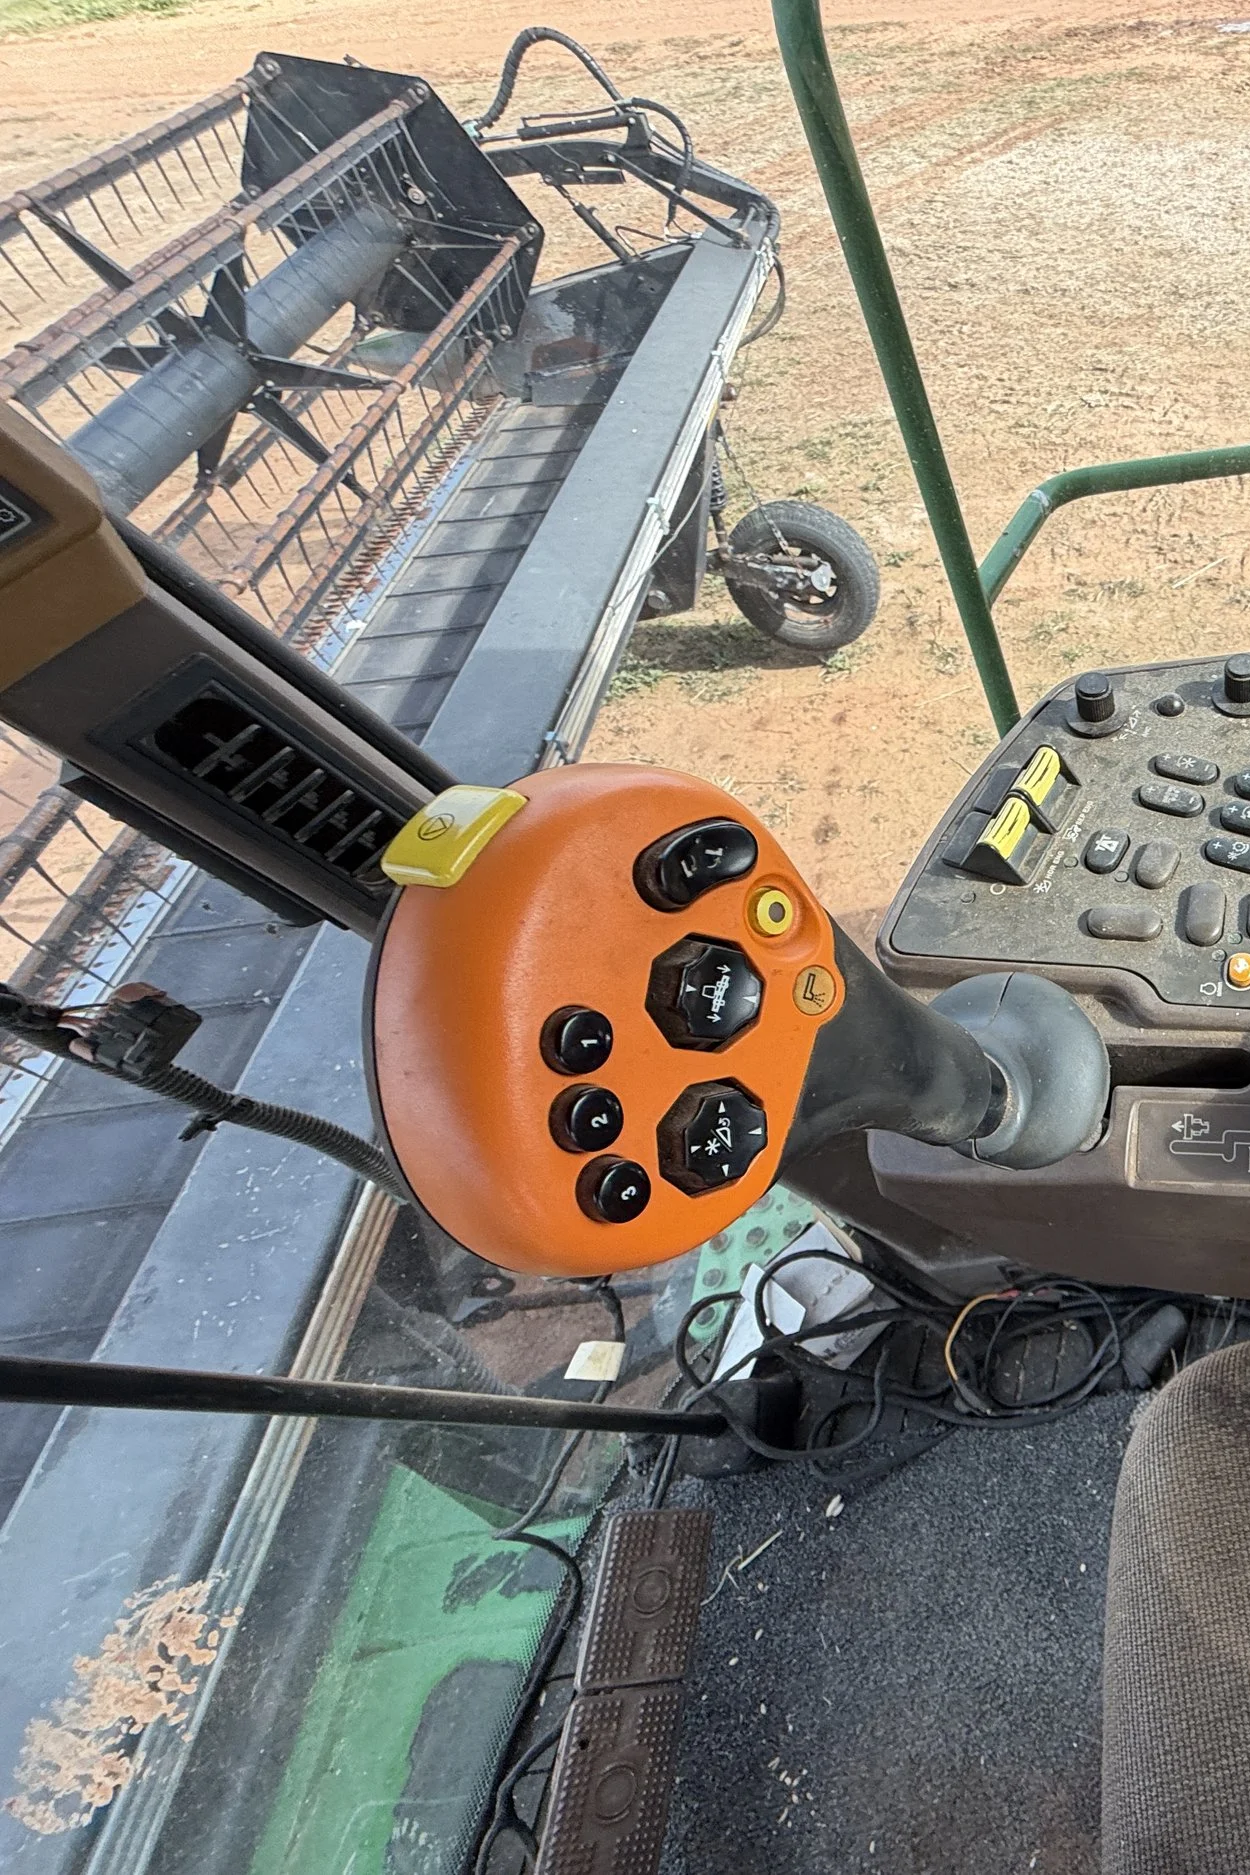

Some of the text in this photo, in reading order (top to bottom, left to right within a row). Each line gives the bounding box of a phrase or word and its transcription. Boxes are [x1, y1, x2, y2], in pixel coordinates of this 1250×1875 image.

[580, 1037, 598, 1049] 1
[591, 1113, 609, 1128] 2
[620, 1184, 637, 1200] 3
